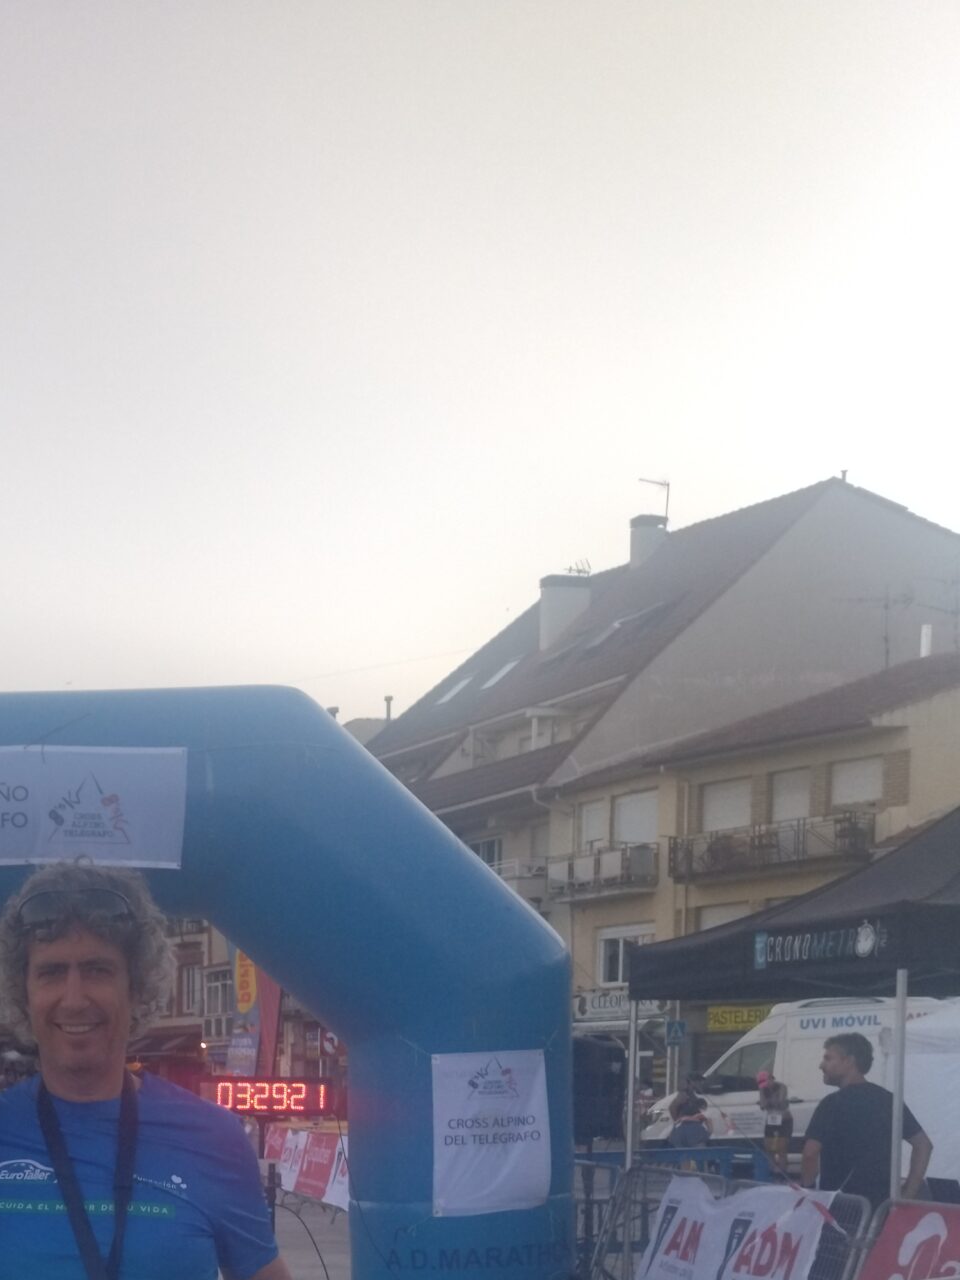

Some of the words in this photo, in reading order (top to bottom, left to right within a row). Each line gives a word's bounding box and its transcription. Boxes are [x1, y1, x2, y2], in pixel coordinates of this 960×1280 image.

[799, 1017, 827, 1030] UVI
[831, 1012, 882, 1029] MÓVIL
[217, 1082, 326, 1110] 03:29:21
[447, 1117, 489, 1131] CROSS
[492, 1114, 536, 1129] ALPINO
[444, 1134, 467, 1147] DEL
[140, 1205, 169, 1215] VIDA
